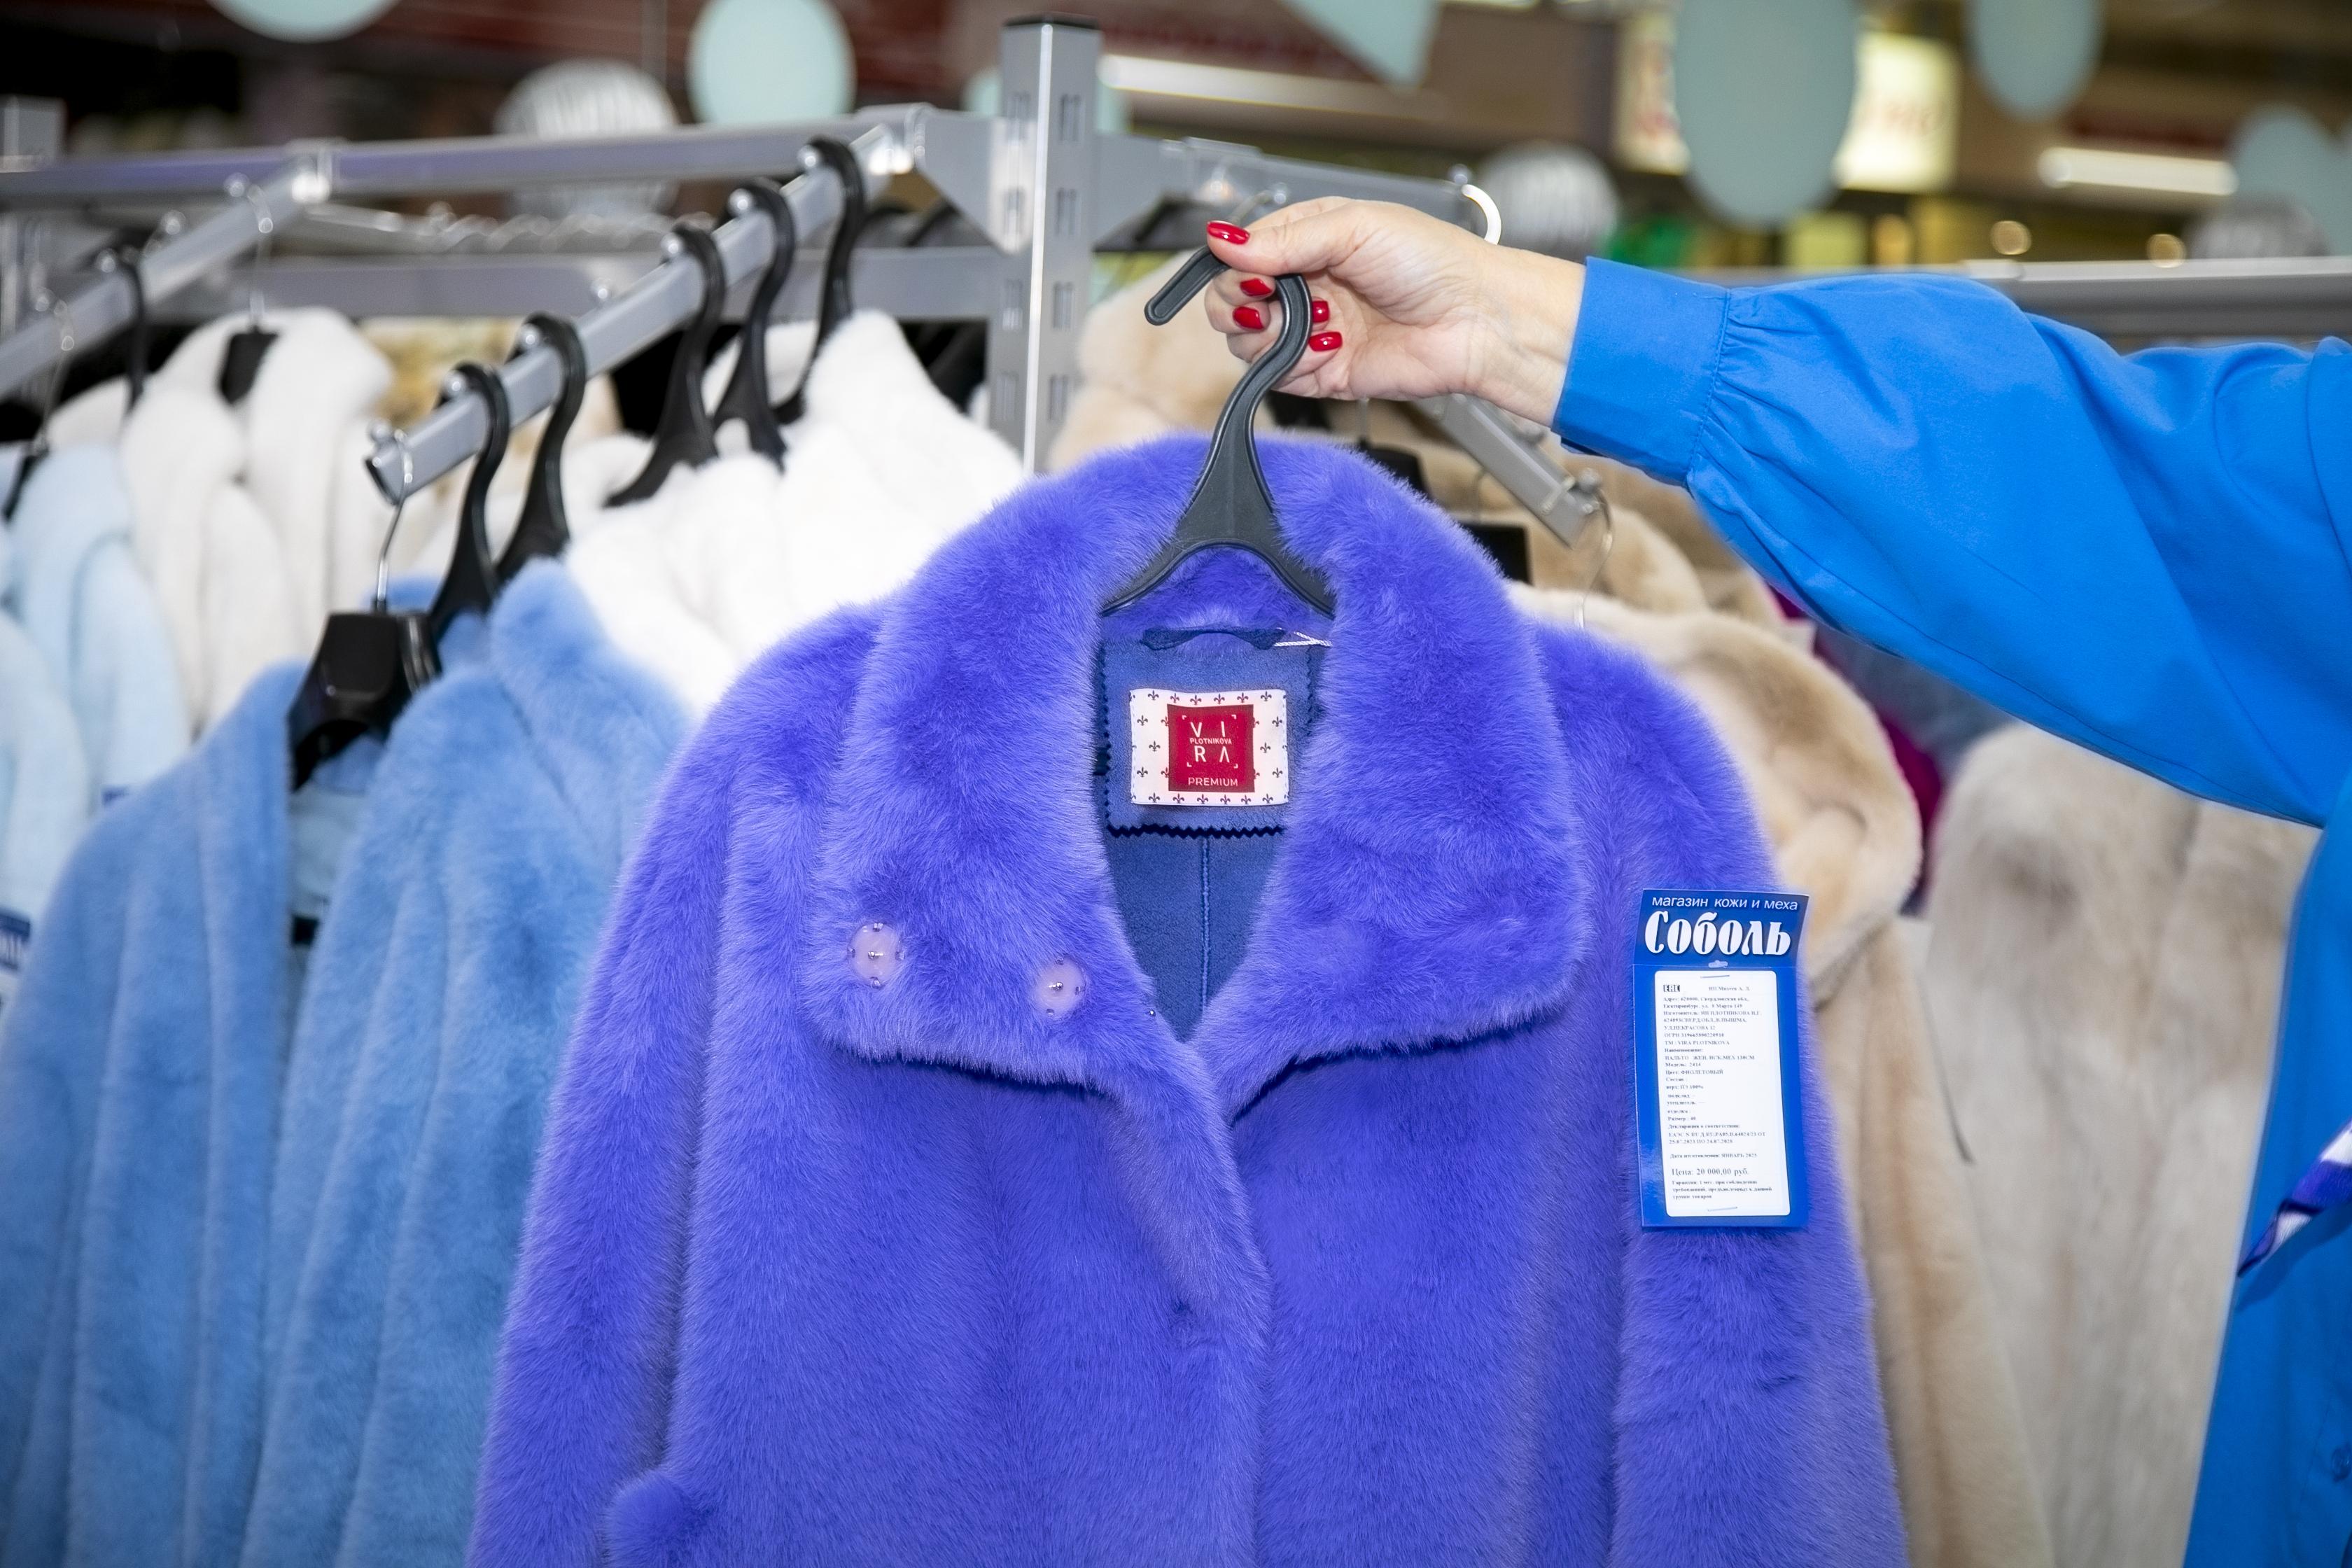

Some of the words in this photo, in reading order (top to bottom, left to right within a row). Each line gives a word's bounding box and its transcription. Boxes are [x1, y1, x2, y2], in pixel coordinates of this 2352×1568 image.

[1188, 777, 1238, 787] PREMIUM
[1652, 897, 1708, 908] магазин
[1714, 897, 1747, 909] кожи
[1751, 899, 1760, 909] и
[1763, 899, 1798, 910] меха
[1645, 910, 1791, 955] Соболь
[1672, 1168, 1693, 1177] Цена:
[1707, 1168, 1732, 1177] 000,00
